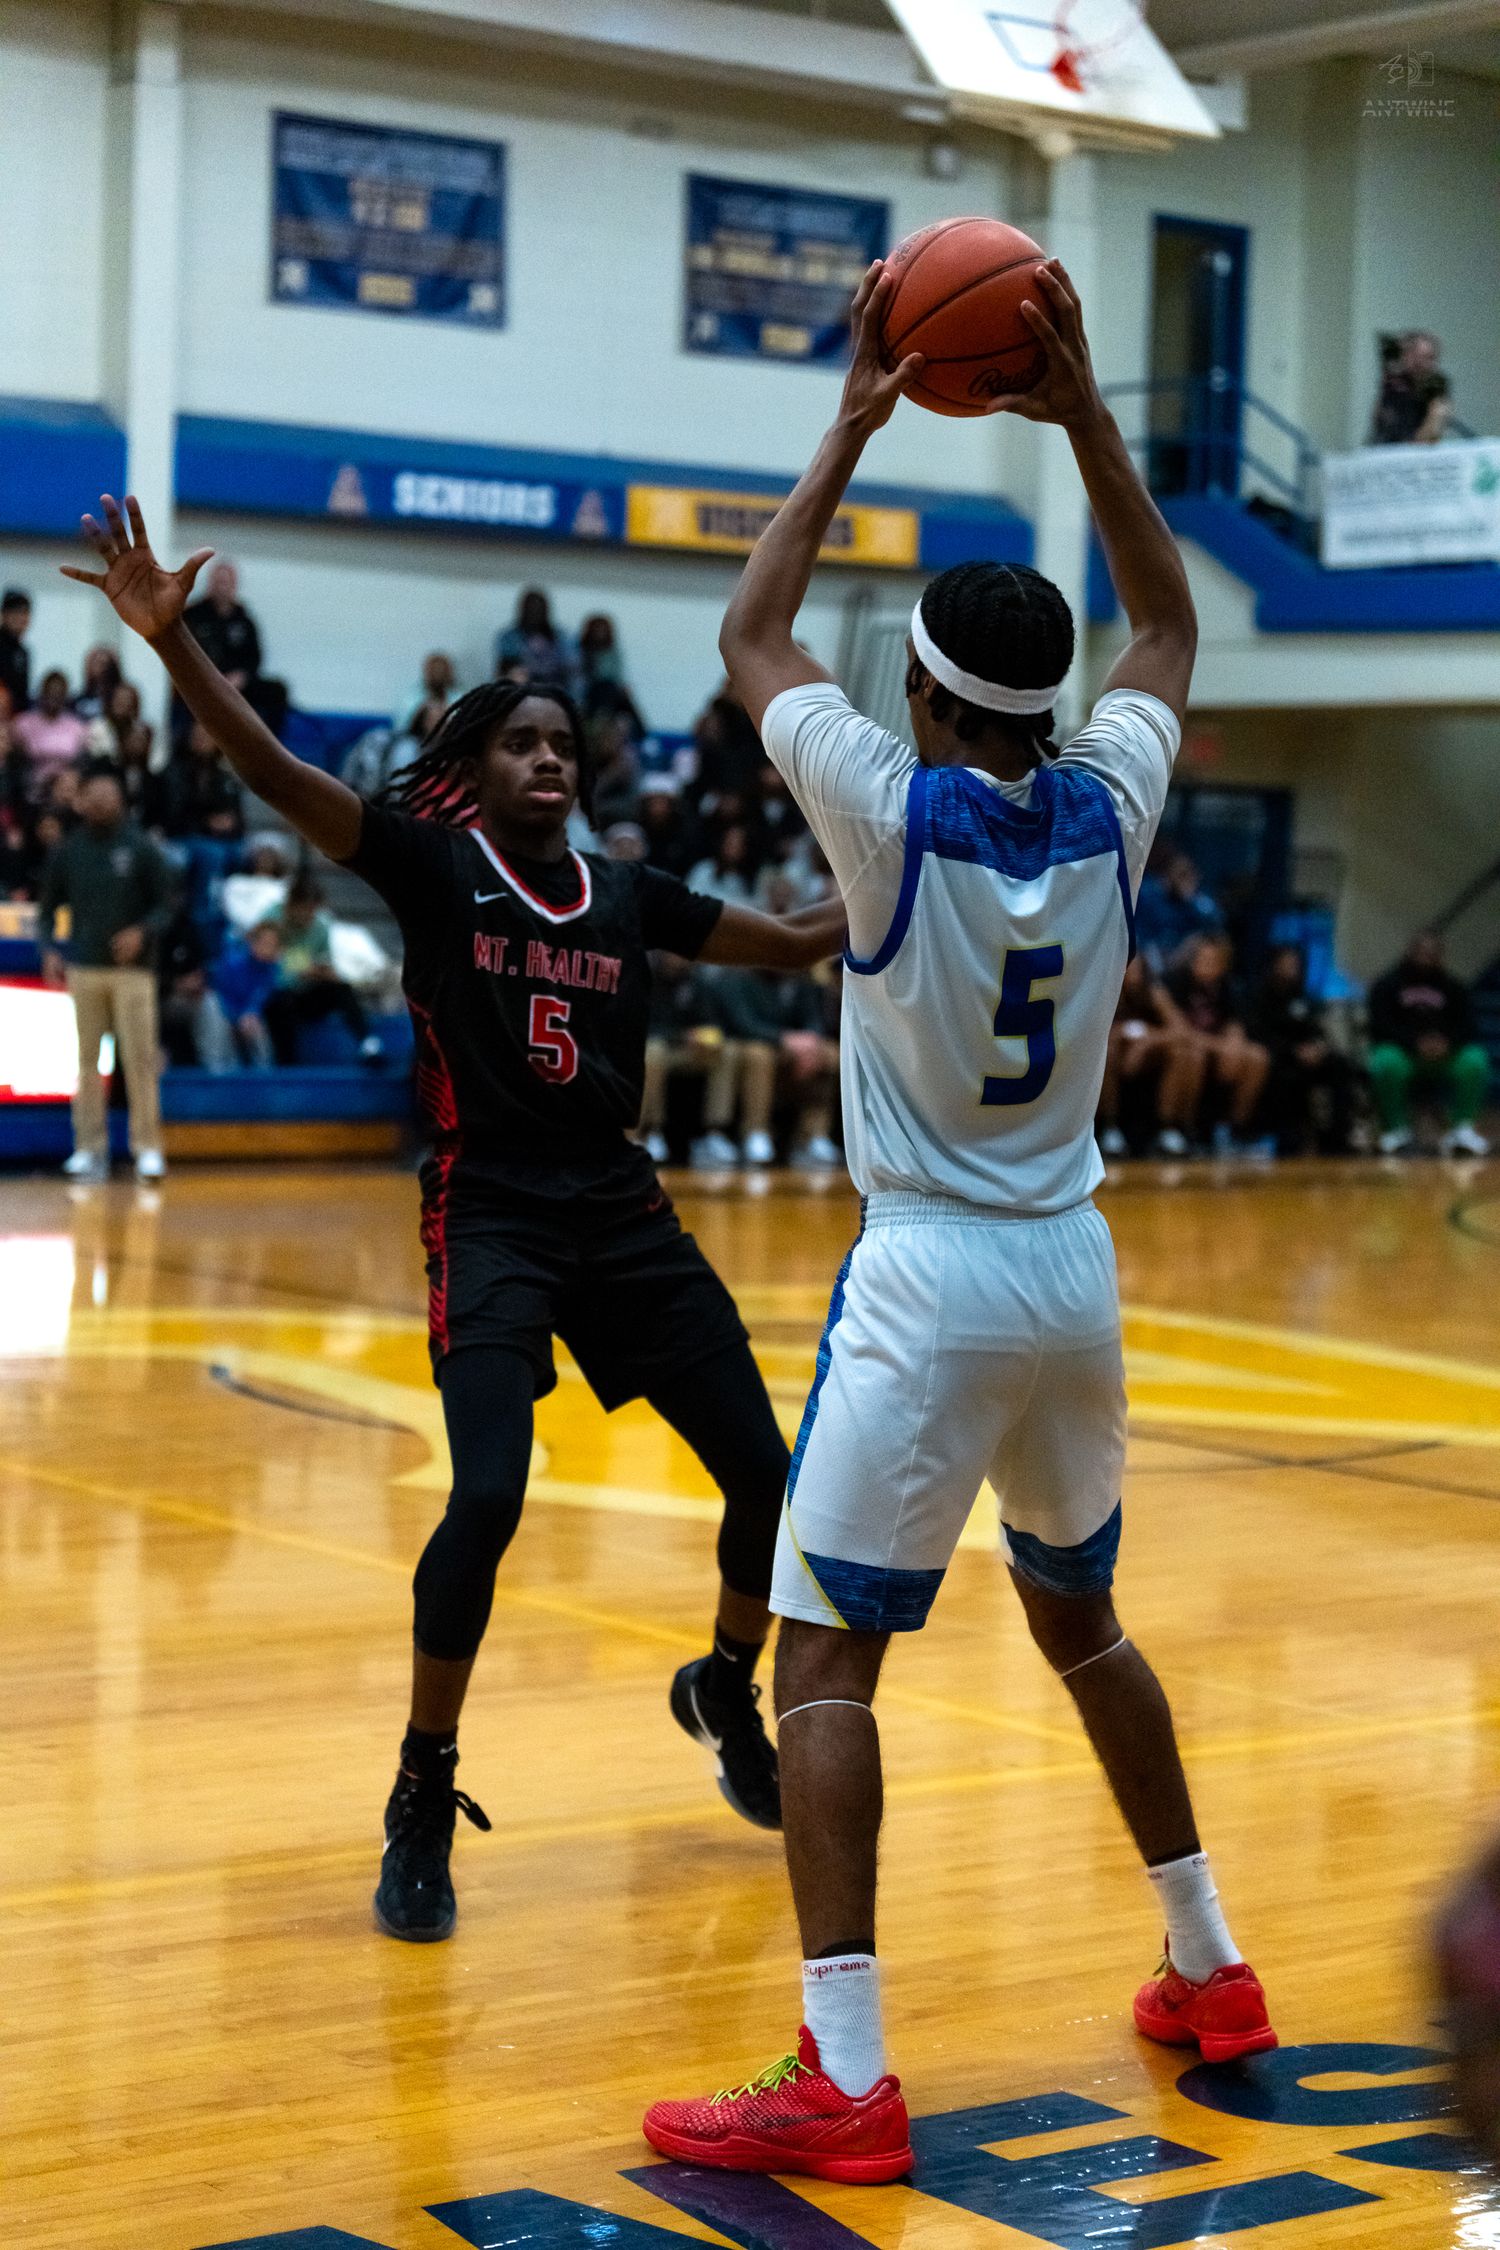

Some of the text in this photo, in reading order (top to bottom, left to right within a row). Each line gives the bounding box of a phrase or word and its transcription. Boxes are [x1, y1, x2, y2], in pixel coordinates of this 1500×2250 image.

[474, 932, 622, 994] MT. HEALTHY
[528, 994, 578, 1085] 5
[979, 941, 1065, 1106] 5
[803, 1961, 871, 1980] Supreme
